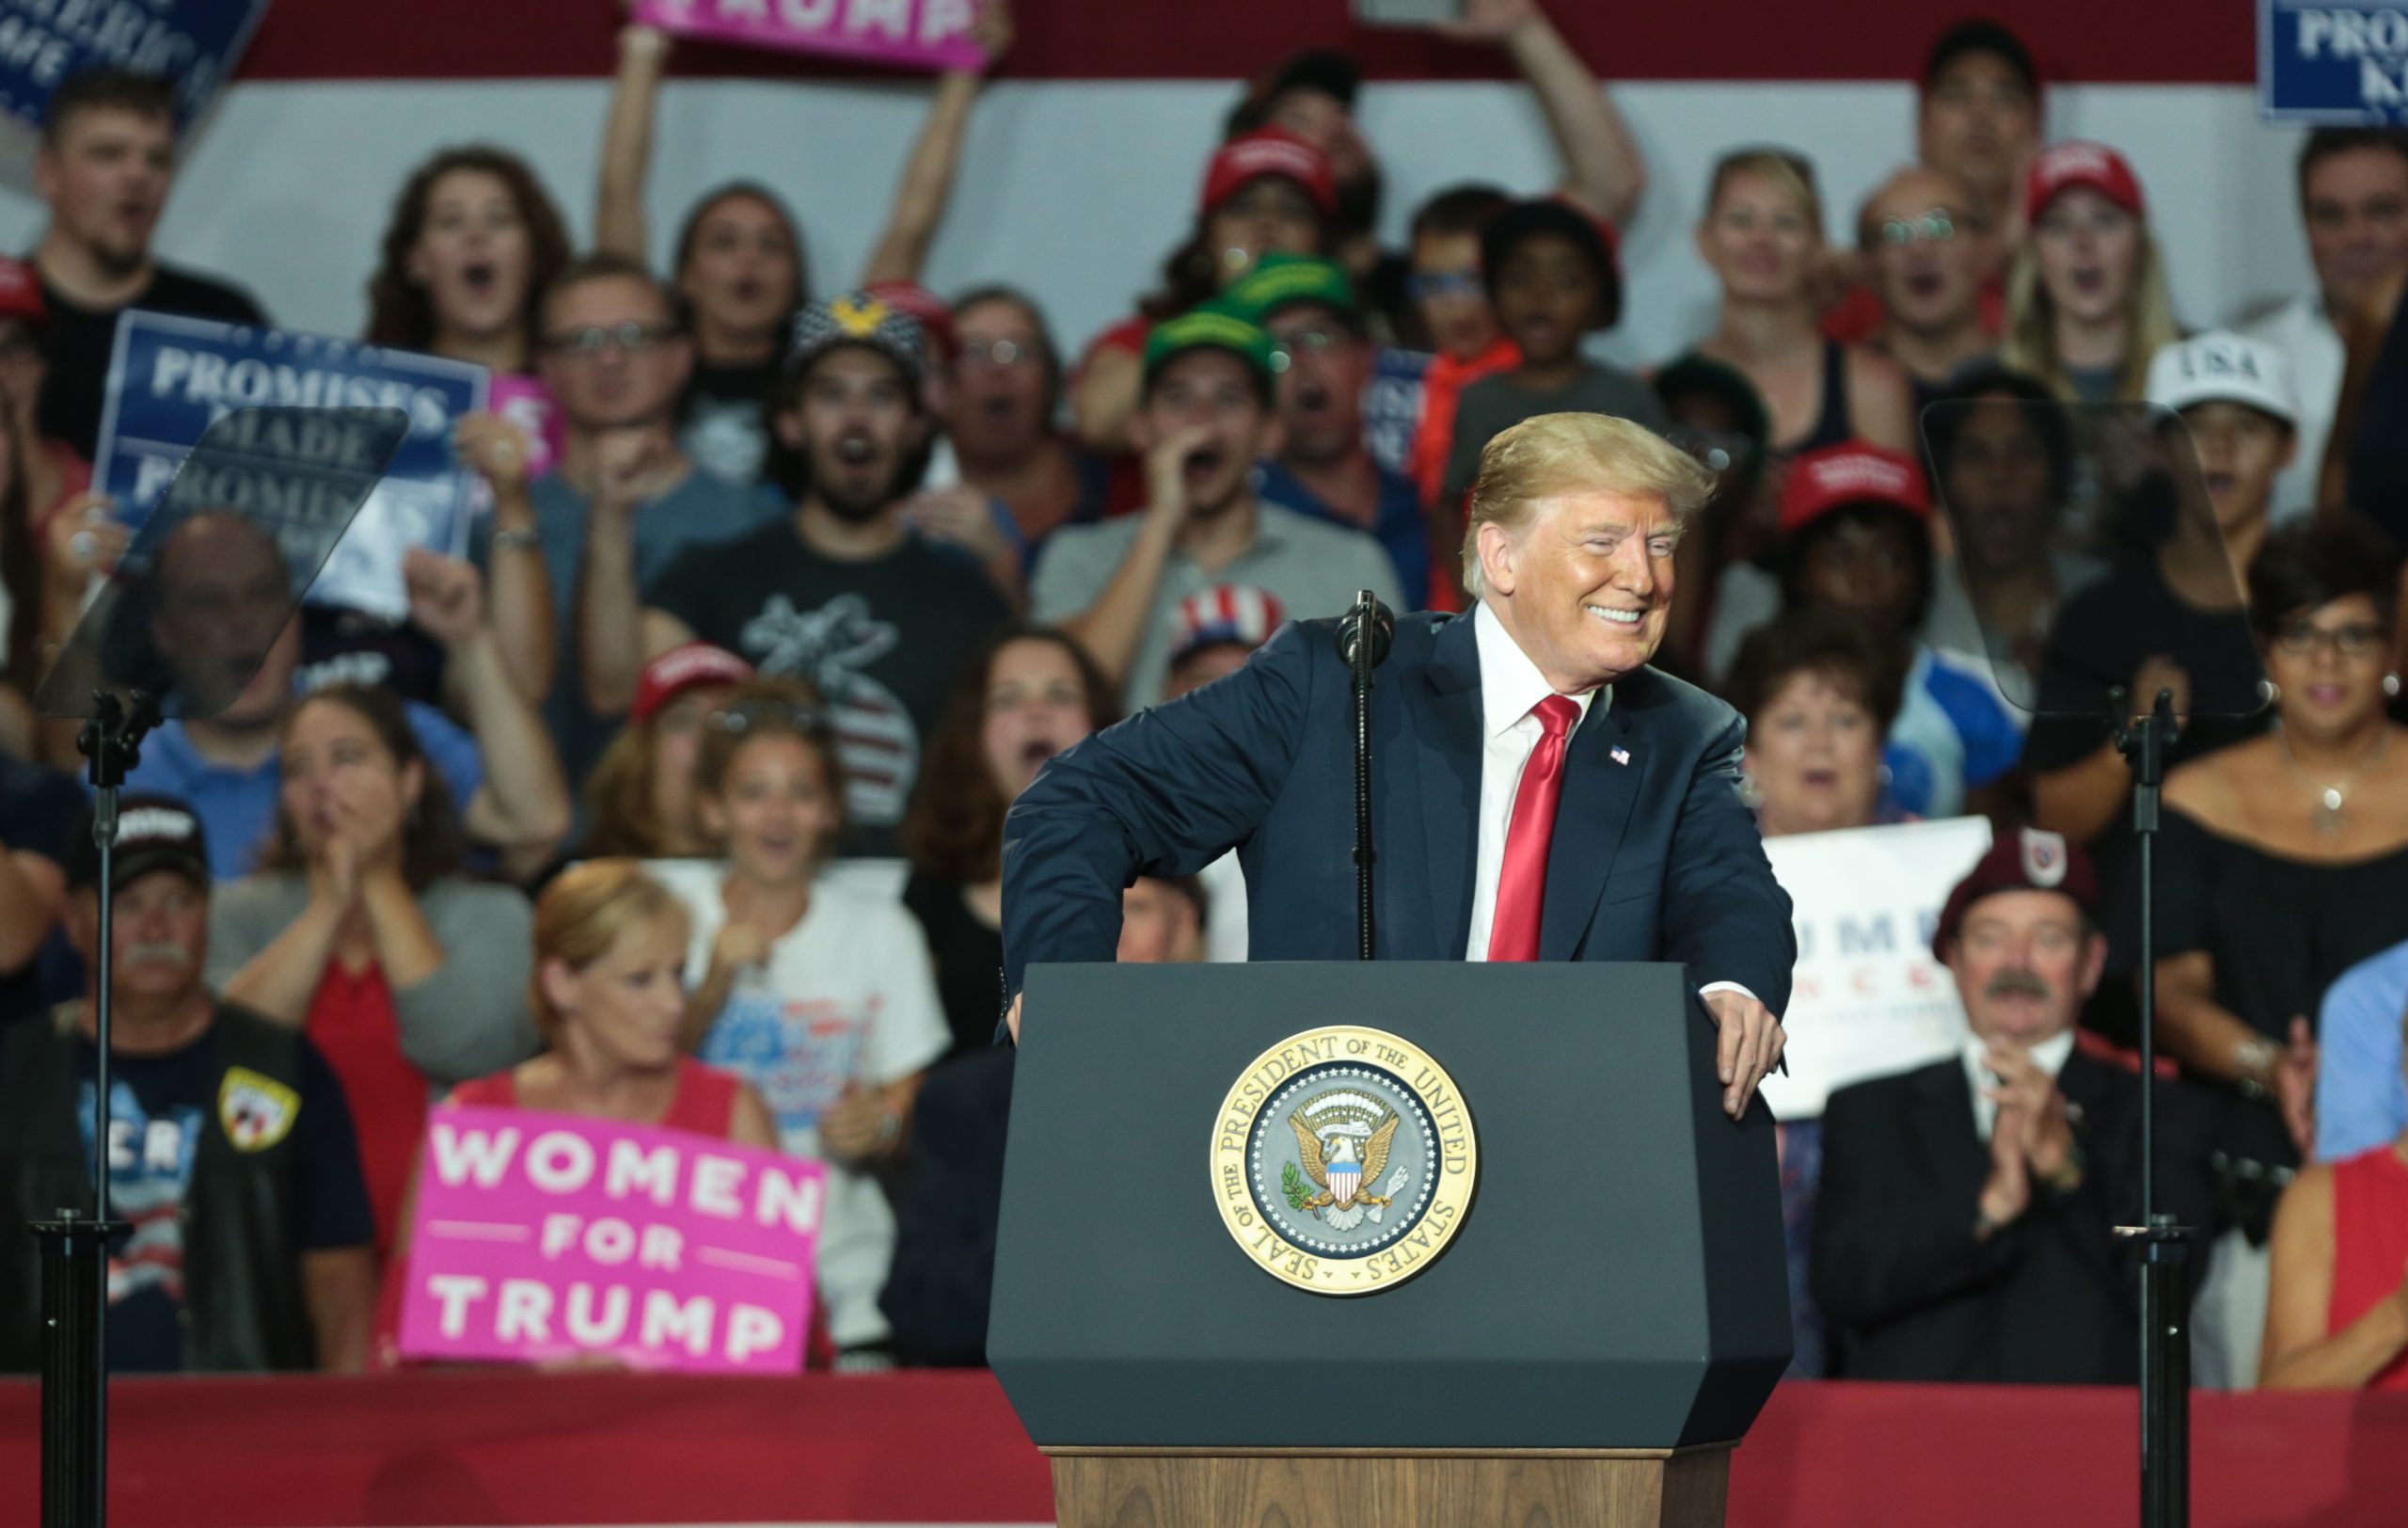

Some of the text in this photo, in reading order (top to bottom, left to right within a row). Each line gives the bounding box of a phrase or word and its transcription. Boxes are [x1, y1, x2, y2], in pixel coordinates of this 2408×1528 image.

[661, 0, 974, 47] UMP
[150, 347, 449, 438] PROMISES
[206, 404, 370, 467] MADE
[431, 1122, 823, 1234] WOMEN
[1221, 1036, 1467, 1281] SEAL OF THE PRESIDENT OF THE UNITED STATES
[540, 1213, 685, 1273] FOR
[426, 1274, 784, 1363] TRUMP
